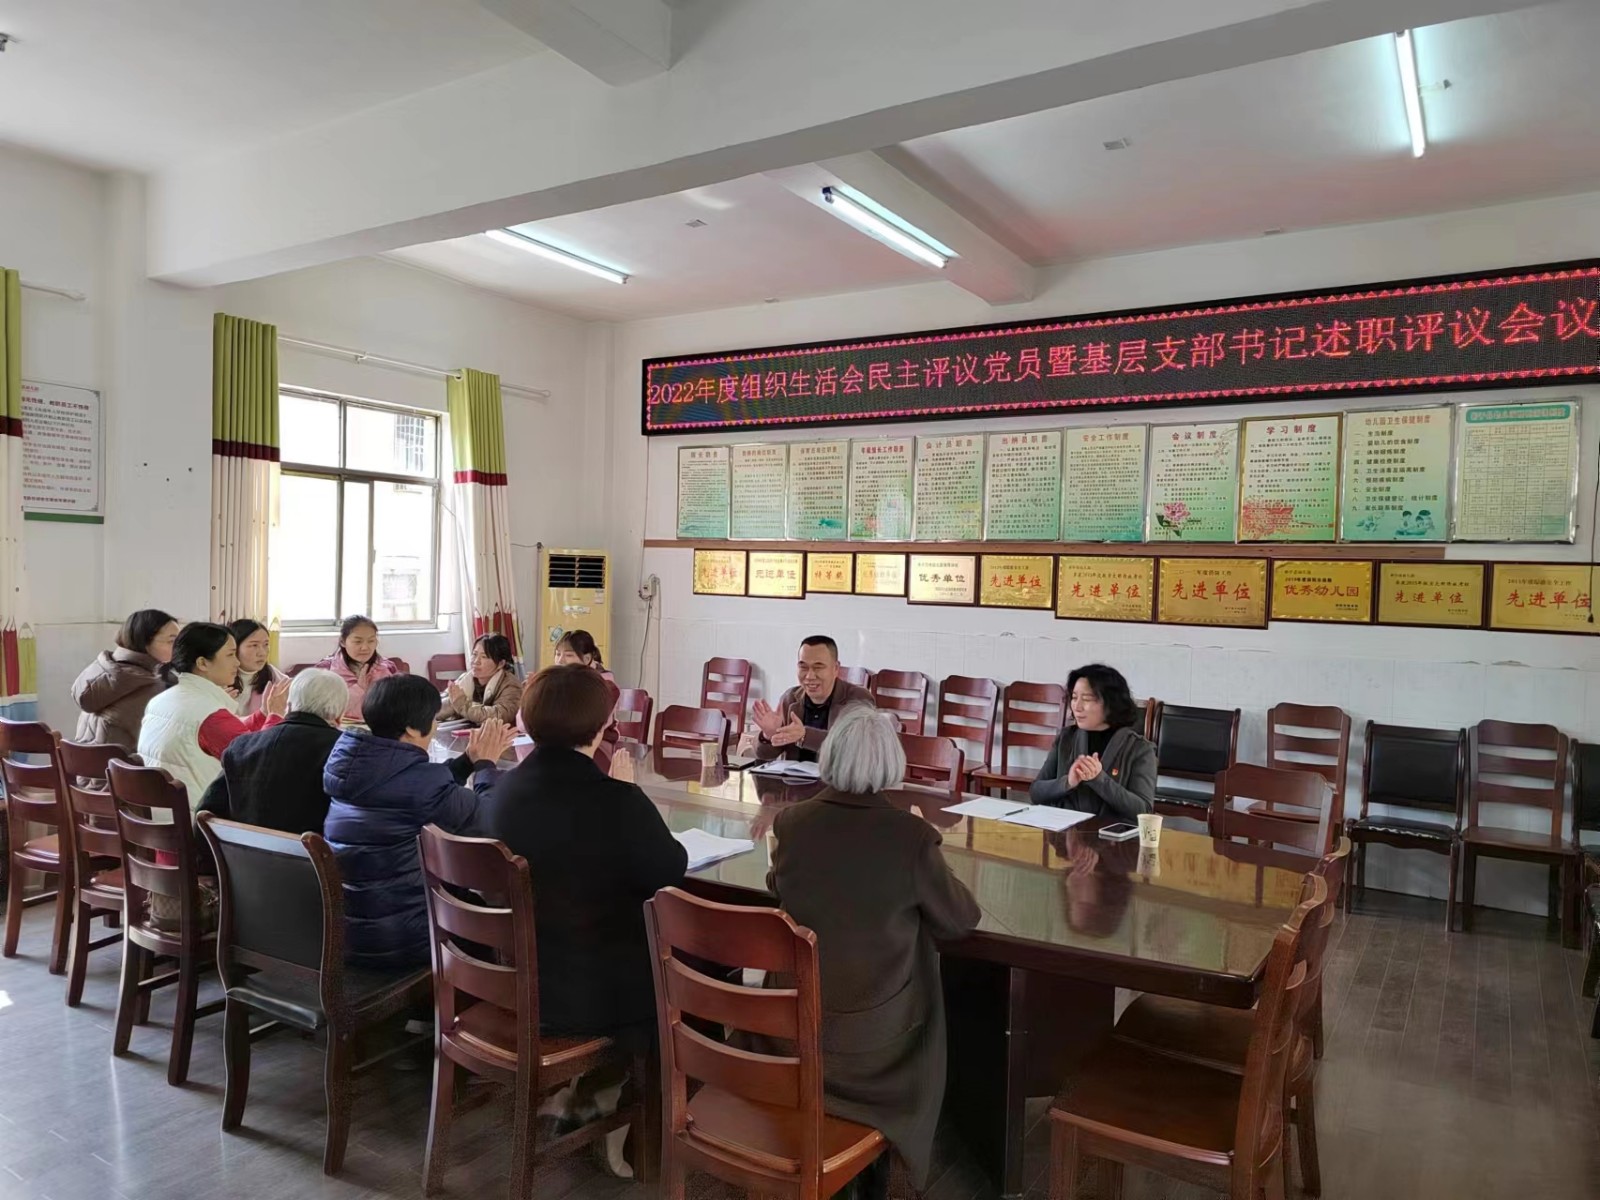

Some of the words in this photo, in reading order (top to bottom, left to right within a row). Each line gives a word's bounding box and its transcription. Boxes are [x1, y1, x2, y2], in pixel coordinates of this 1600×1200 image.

[649, 296, 1600, 404] 2022年度组织生活会民主评议党员暨基层支部书记述职评议会议
[1365, 415, 1431, 426] 幼儿园卫生保健制度
[1171, 430, 1218, 440] 会议制度
[1266, 424, 1317, 434] 学习制度
[1001, 434, 1048, 444] 出纳员职责
[1082, 432, 1129, 441] 安全工作制度
[926, 439, 973, 449] 会计员职责
[919, 573, 966, 583] 优秀单位
[990, 574, 1042, 588] 先进单位
[1071, 581, 1141, 599] 先进单位
[1171, 579, 1251, 602] 先进单位
[1284, 584, 1359, 597] 优秀幼儿园
[1394, 590, 1464, 605] 先进单位
[1505, 589, 1590, 610] 先进单位
